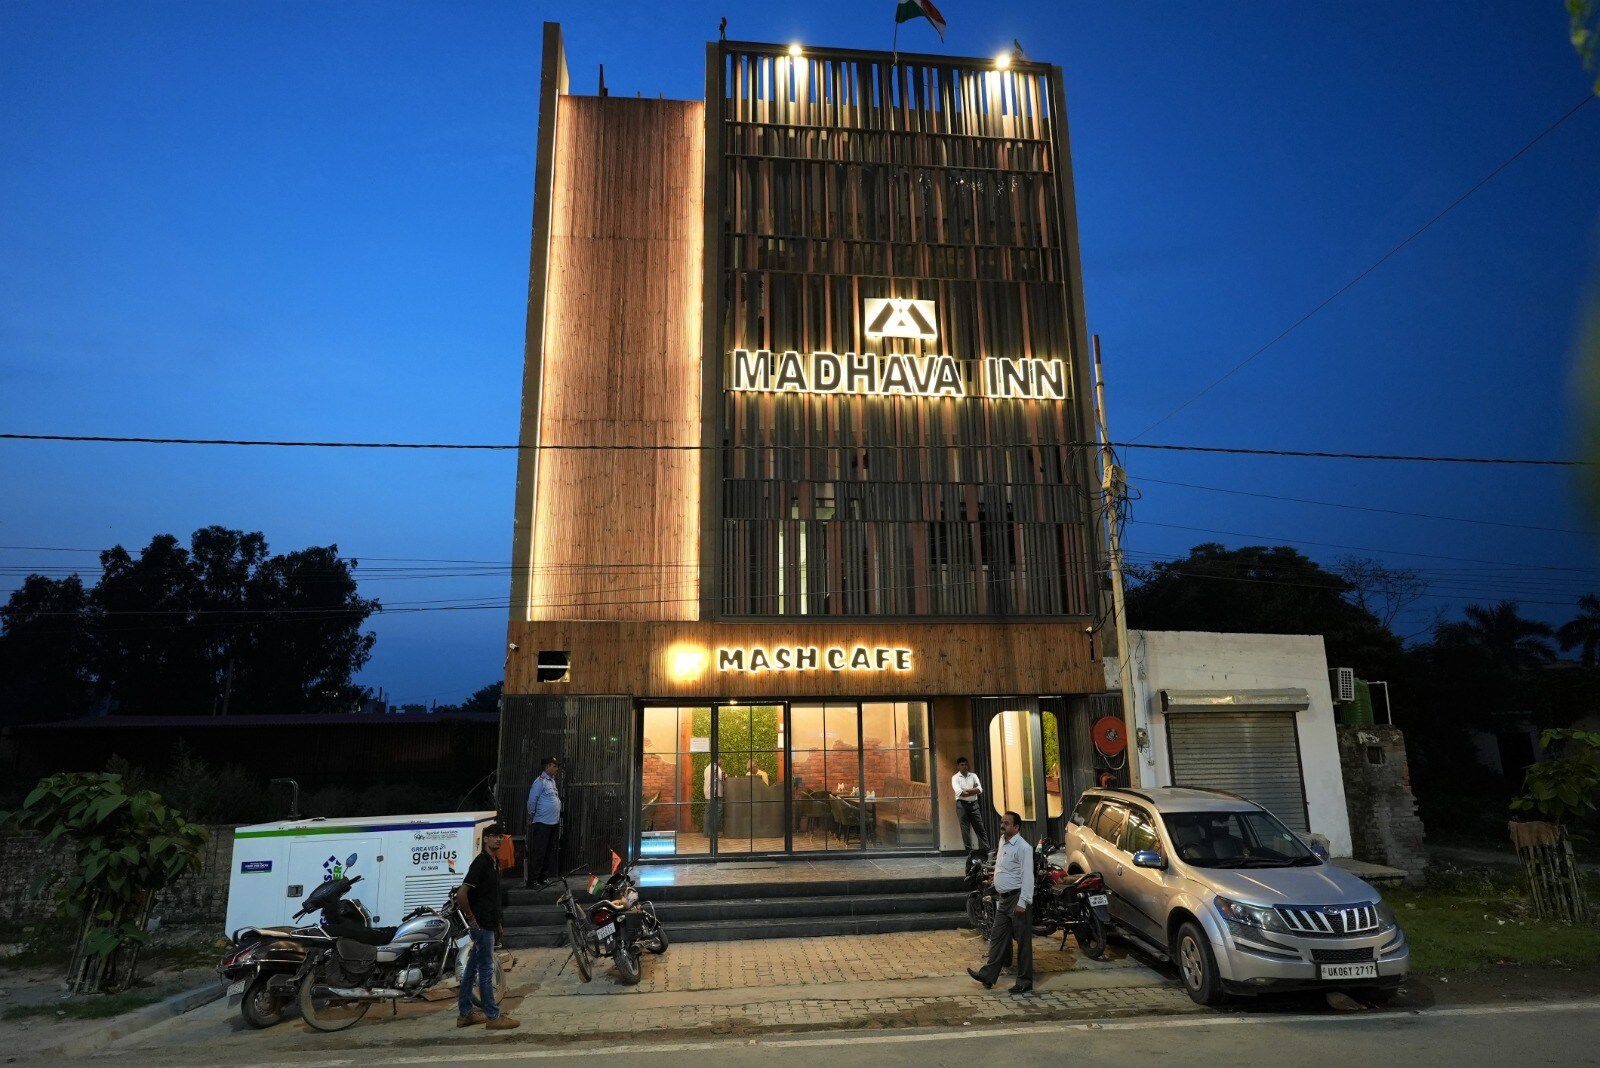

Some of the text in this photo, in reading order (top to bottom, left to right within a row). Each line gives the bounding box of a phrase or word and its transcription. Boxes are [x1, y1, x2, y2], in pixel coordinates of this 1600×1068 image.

[734, 349, 1065, 399] MADHAVA INN
[719, 648, 912, 672] MASH CAFE
[412, 848, 457, 865] genius
[1356, 965, 1374, 976] 2717
